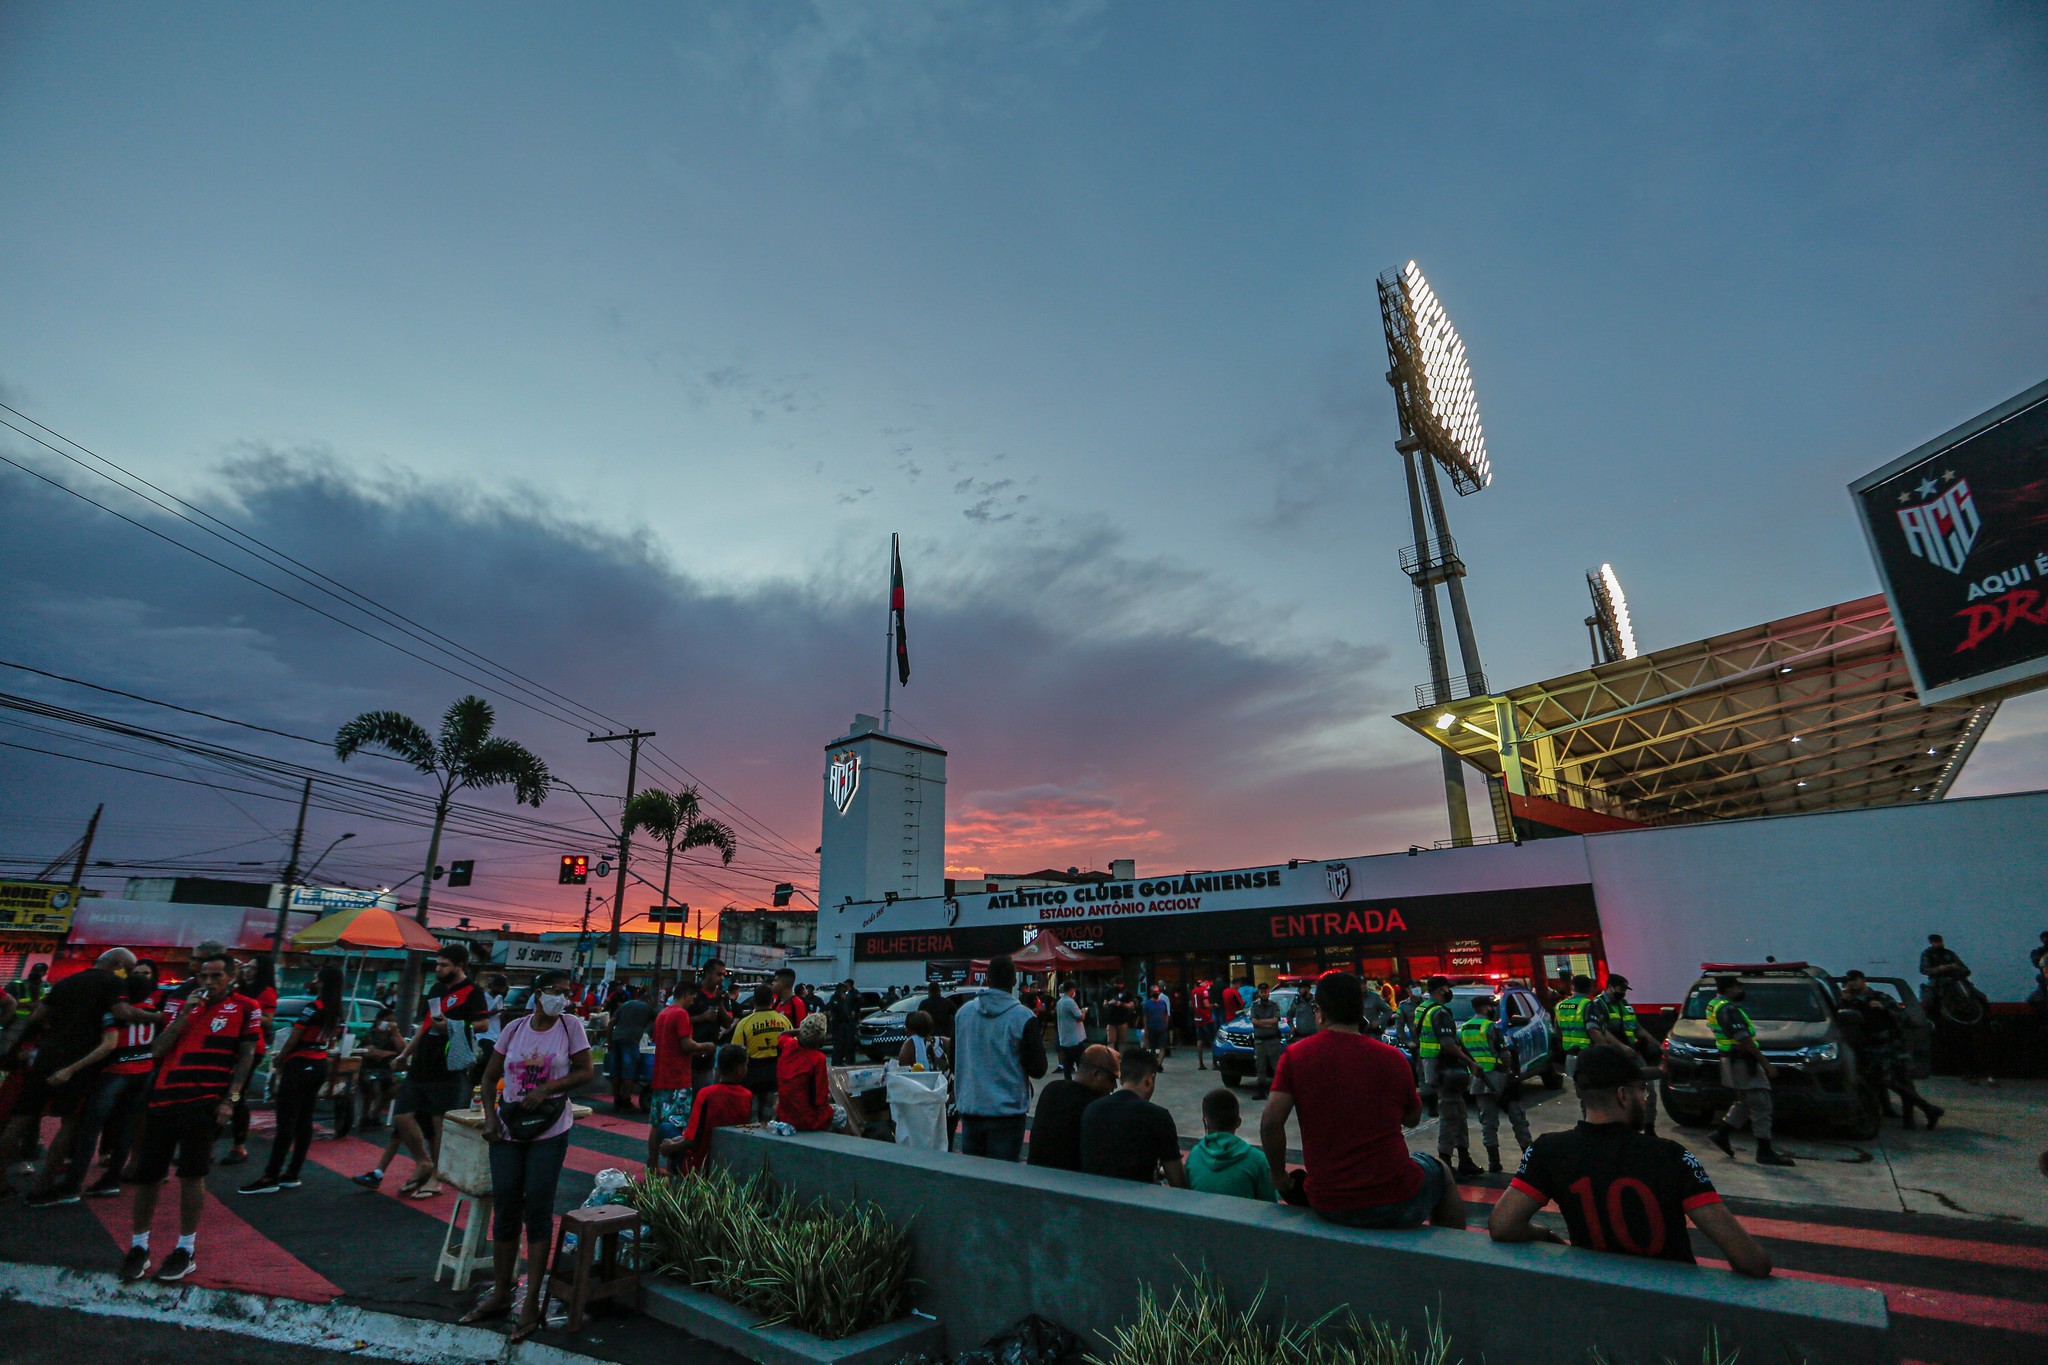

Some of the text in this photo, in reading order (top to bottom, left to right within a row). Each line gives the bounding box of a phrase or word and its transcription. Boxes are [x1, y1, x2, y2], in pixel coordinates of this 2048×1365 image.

[1967, 564, 2031, 601] AQUI
[1950, 588, 2048, 655] DR
[1074, 884, 1134, 903] CLUBE
[1040, 897, 1201, 920] ESTÁDIO ANTÔNIO ACCIOLY
[1270, 908, 1407, 938] ENTRADA
[867, 934, 954, 954] BILHETERIA
[1064, 940, 1094, 950] TORE
[529, 949, 563, 963] SUPORTES
[128, 1023, 155, 1047] 10
[1569, 1175, 1665, 1256] 10
